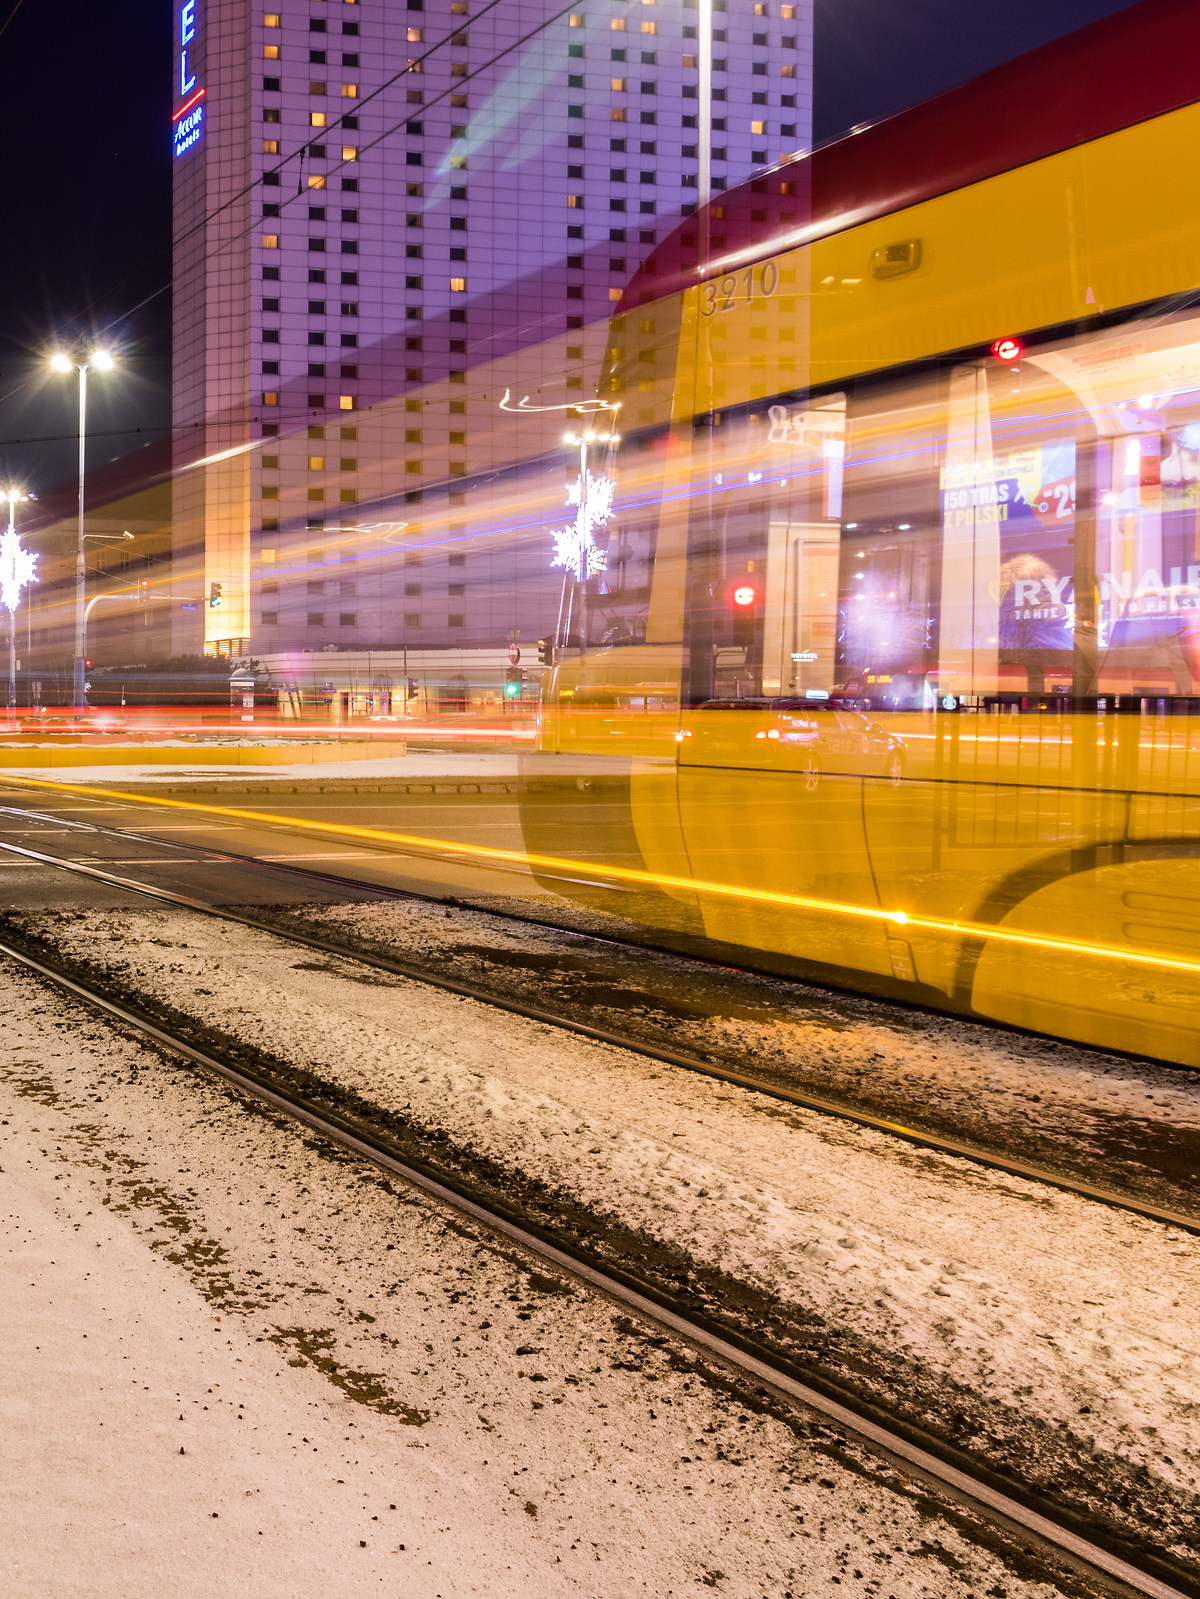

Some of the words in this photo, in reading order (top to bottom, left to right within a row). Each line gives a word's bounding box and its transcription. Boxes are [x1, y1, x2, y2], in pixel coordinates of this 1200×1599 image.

[176, 128, 200, 156] hotels
[701, 260, 779, 318] 3210
[944, 490, 966, 510] 150
[971, 483, 1009, 506] TRAS
[944, 511, 953, 529] Z
[956, 504, 1008, 527] POLSKI
[1015, 566, 1200, 607] RYNAI
[1015, 607, 1059, 621] TANIE
[867, 674, 876, 683] 35
